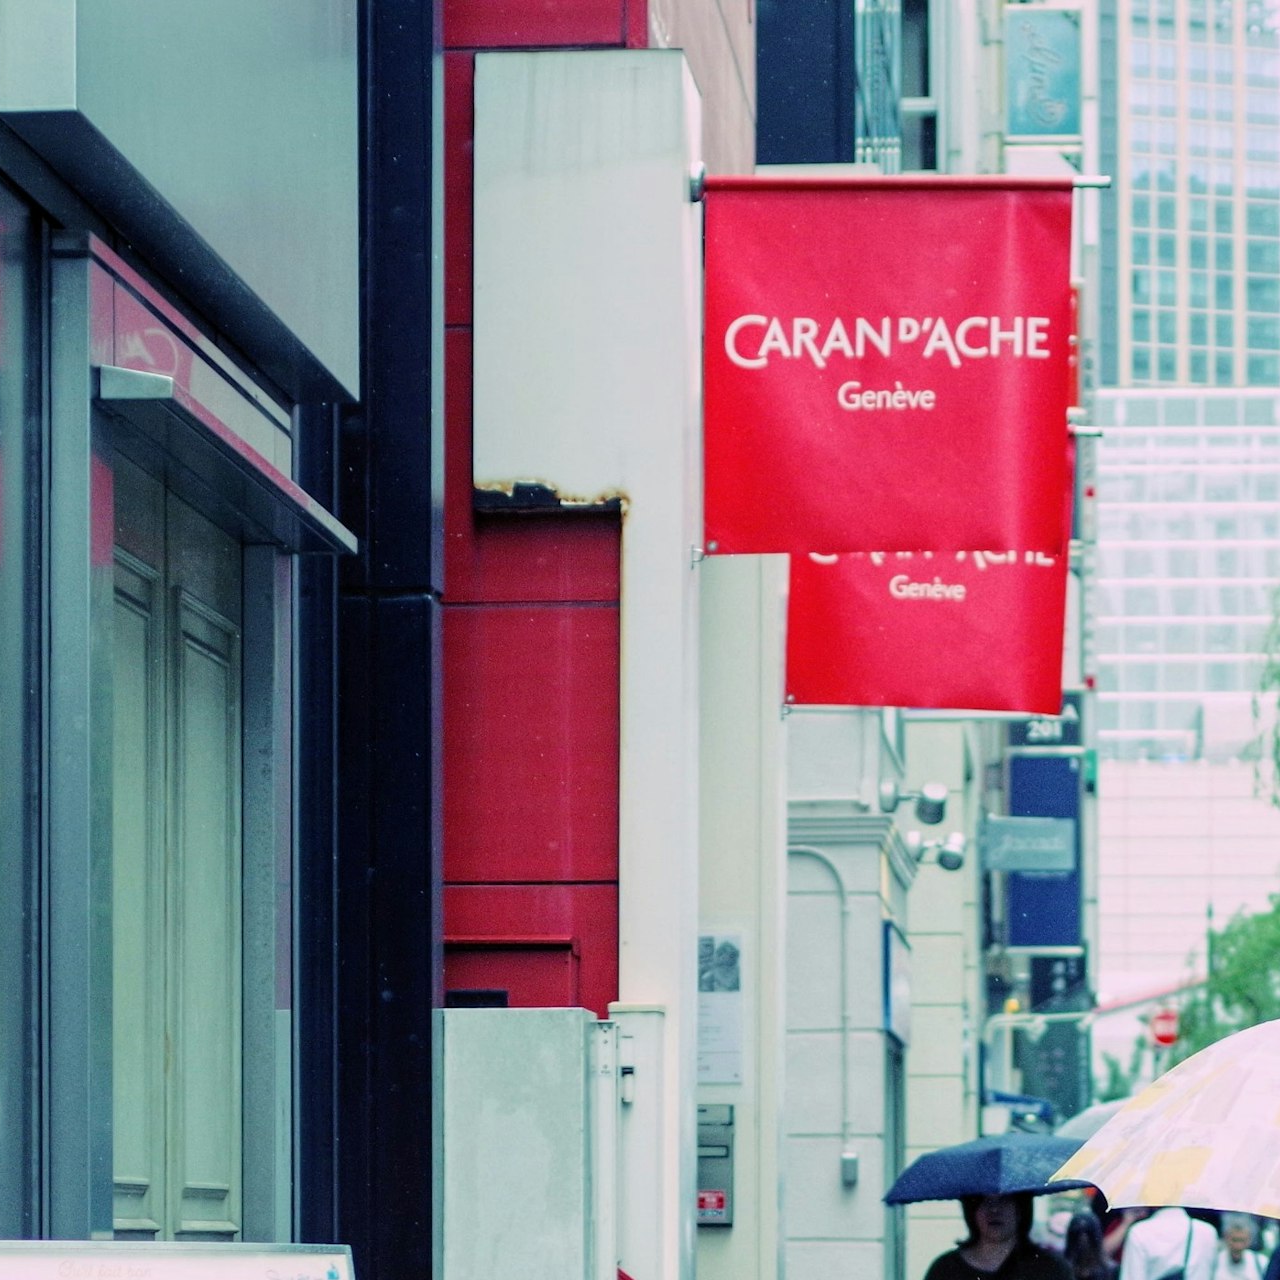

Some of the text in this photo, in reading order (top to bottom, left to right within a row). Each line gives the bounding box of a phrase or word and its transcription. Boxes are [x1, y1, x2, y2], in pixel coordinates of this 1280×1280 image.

[724, 313, 891, 369] CARAN
[837, 380, 936, 411] Genève
[888, 573, 967, 602] Genève
